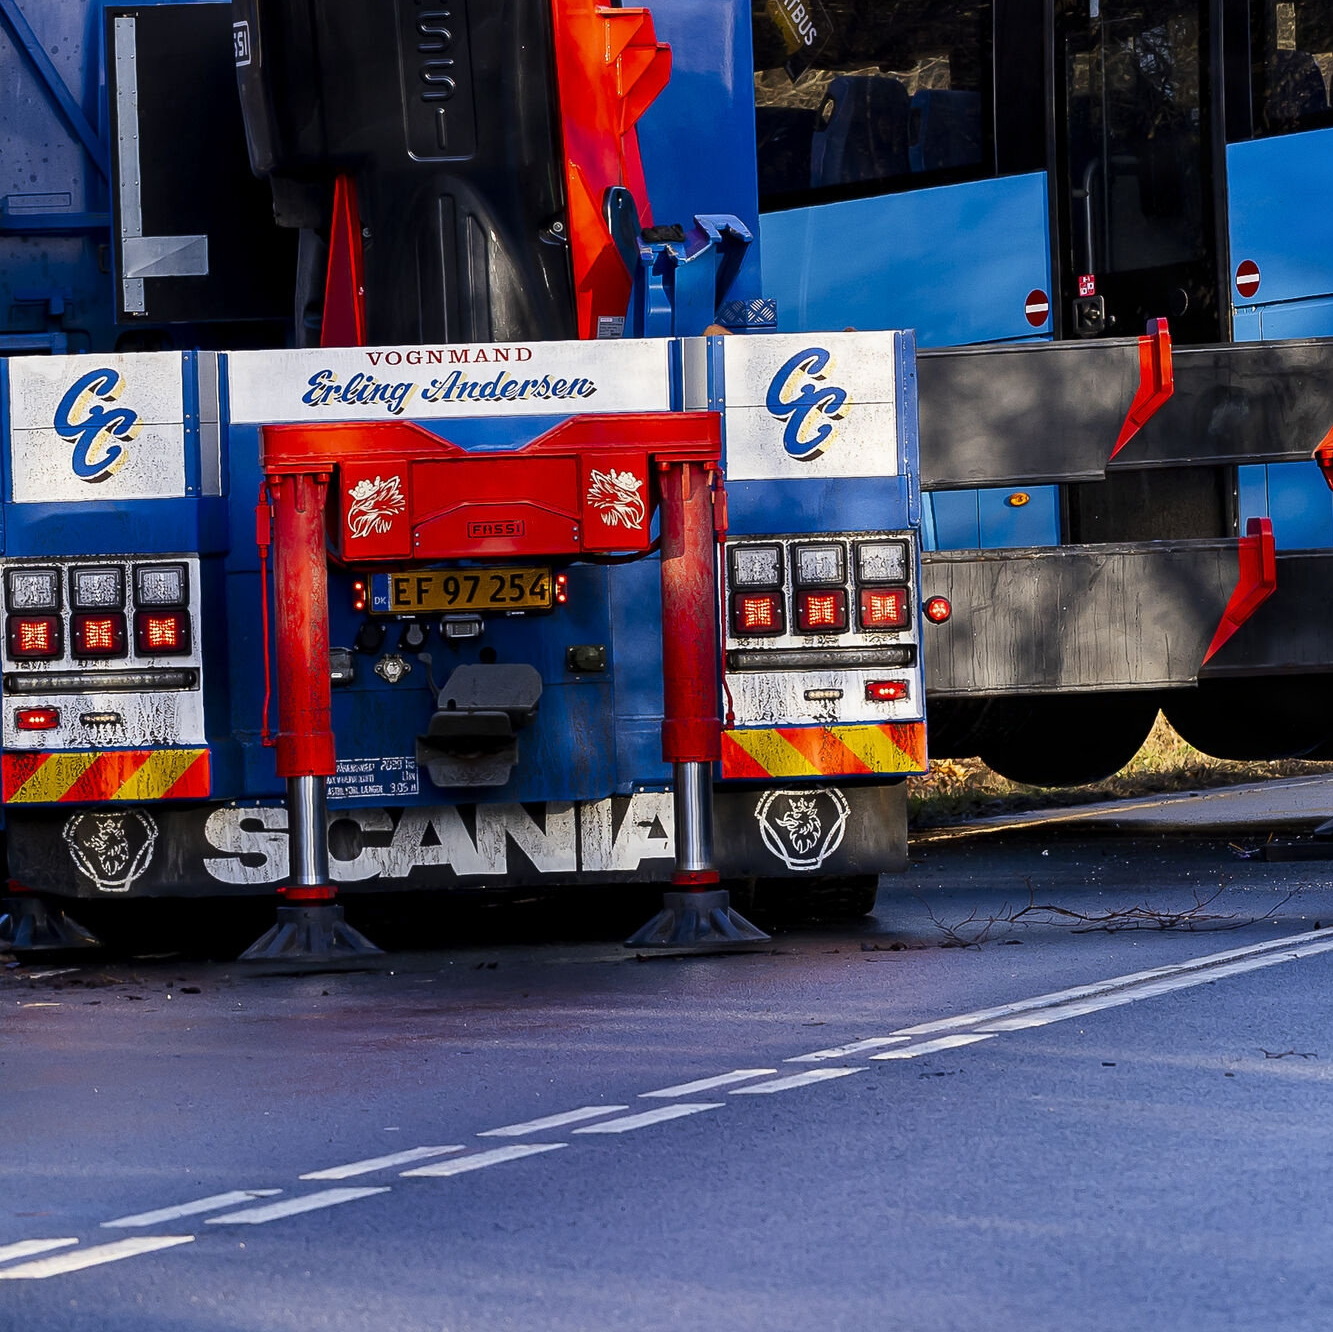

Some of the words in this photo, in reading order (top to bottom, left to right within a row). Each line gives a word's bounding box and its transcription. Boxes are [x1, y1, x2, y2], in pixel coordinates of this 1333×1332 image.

[366, 347, 533, 366] VOGNMAND
[302, 369, 417, 415] Erling
[421, 370, 597, 401] Andersen
[472, 522, 521, 535] FASSI
[373, 594, 387, 606] DK
[393, 577, 433, 606] EF
[443, 576, 482, 605] 97
[489, 572, 548, 604] 254
[203, 792, 676, 885] SCANIA
